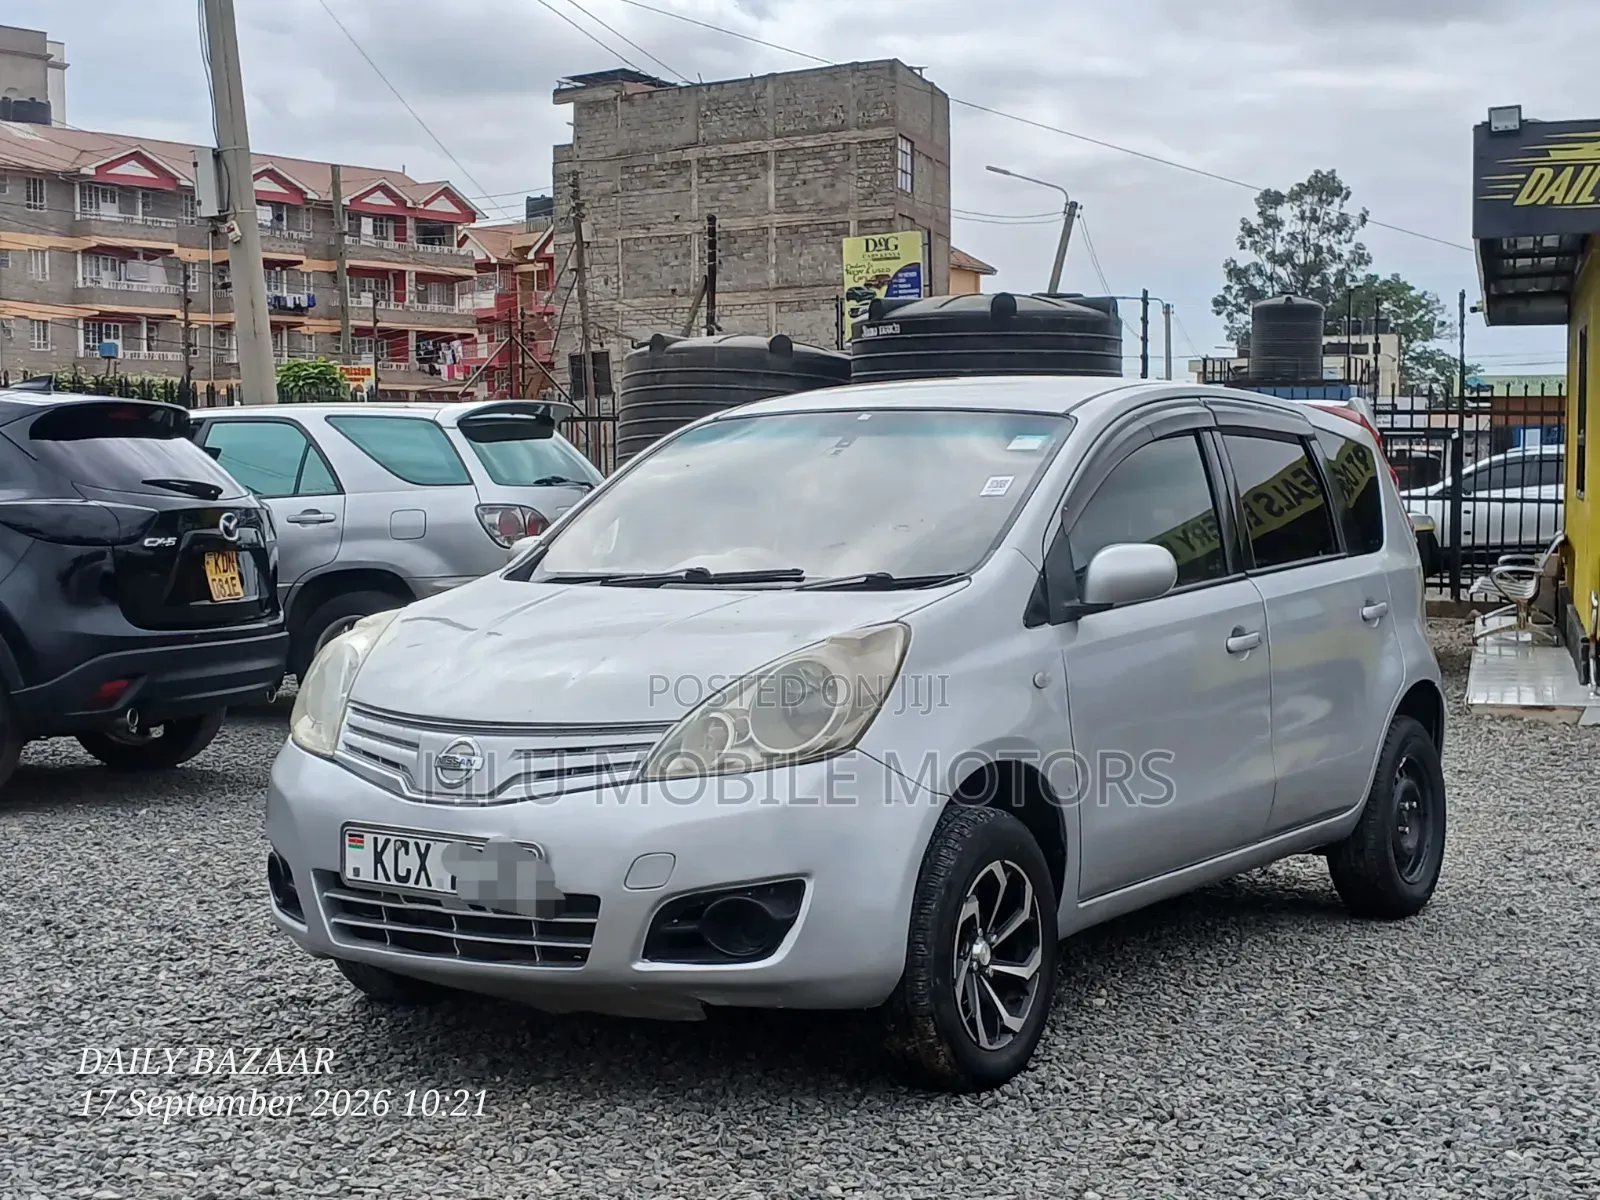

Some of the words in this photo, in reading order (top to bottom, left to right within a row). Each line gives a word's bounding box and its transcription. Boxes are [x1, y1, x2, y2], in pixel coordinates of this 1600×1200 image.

[1513, 165, 1600, 206] DAIL
[213, 551, 237, 574] KDN
[437, 755, 477, 768] NISSAN
[372, 835, 432, 888] KCX
